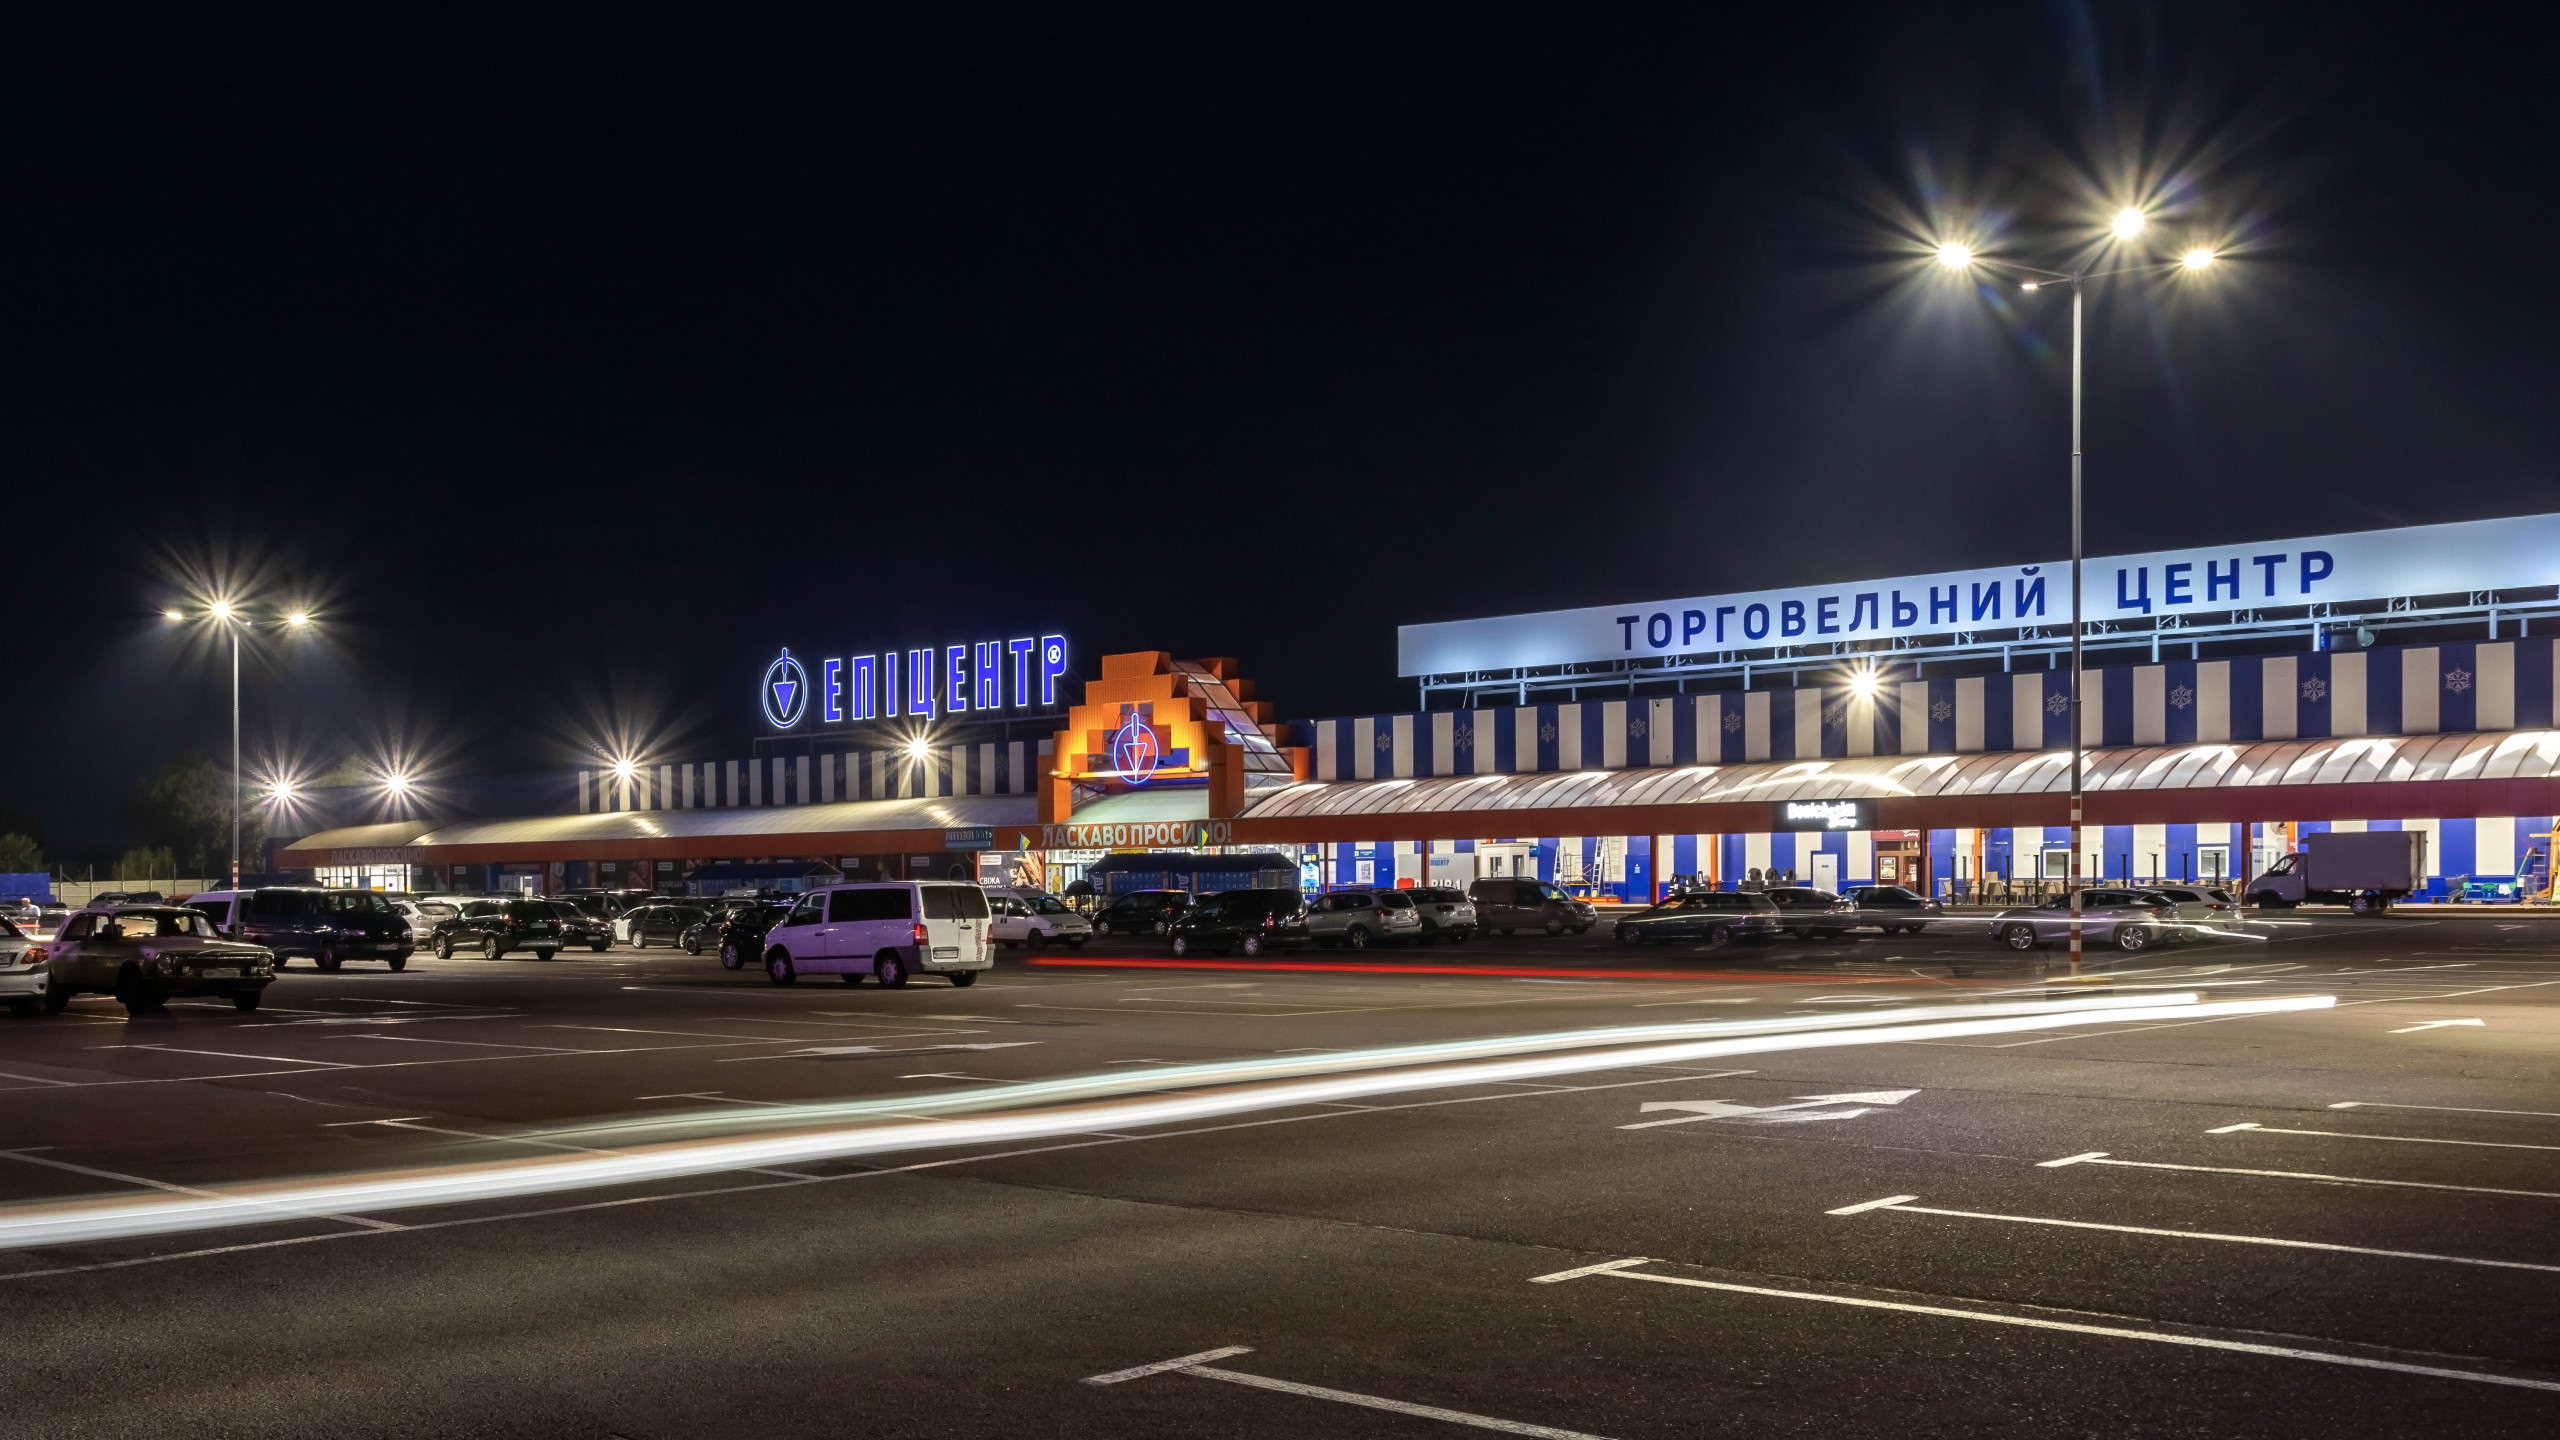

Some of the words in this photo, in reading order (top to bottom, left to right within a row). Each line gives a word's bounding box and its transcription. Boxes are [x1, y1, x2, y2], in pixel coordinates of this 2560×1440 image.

[1616, 567, 2047, 651] ТОРГОВЕЛЬНИЙ
[2117, 550, 2334, 609] ЦЕНТР
[824, 634, 1066, 721] ЕПІЦЕНТР
[1041, 824, 1127, 847] ЛАСКАВО
[331, 849, 374, 864] ЛАСКАВО
[376, 847, 425, 863] ПРОСИМО!
[979, 876, 1001, 886] СВІЖА
